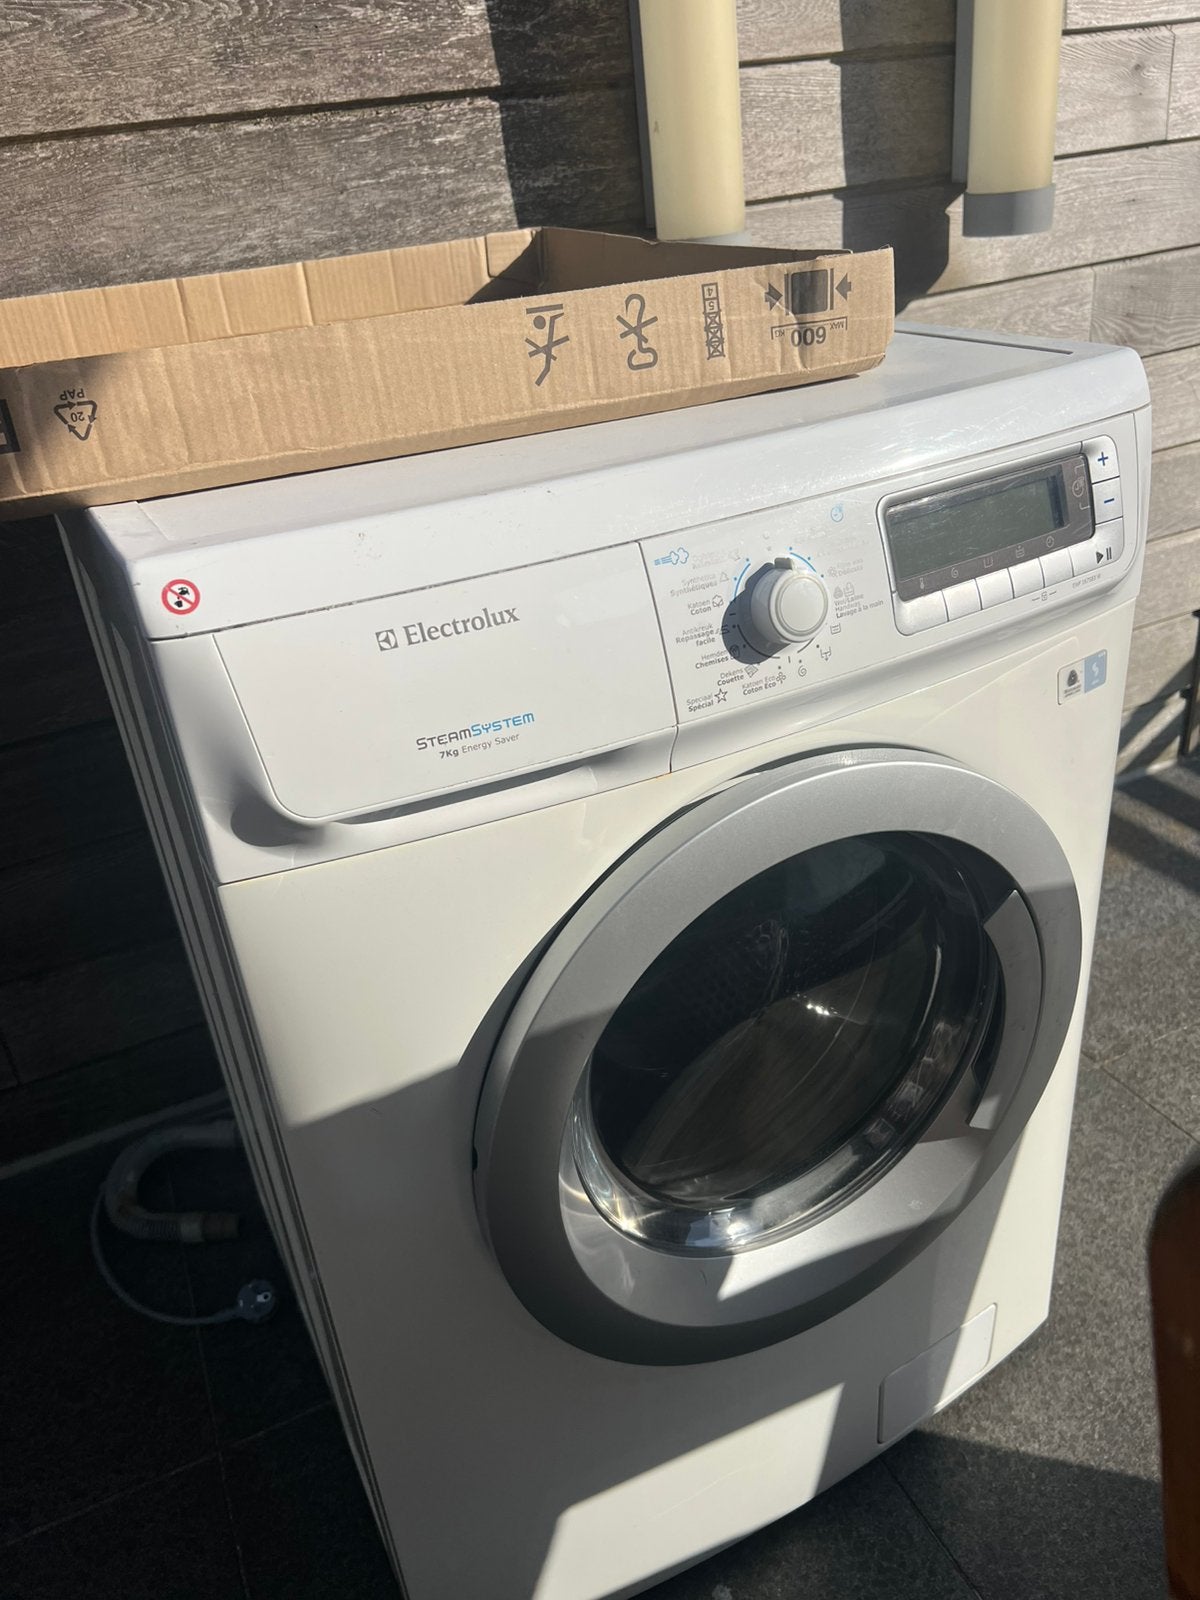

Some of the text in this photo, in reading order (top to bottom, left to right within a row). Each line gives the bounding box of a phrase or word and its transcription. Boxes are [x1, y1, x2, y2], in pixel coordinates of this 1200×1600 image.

[707, 287, 714, 297] 4
[708, 300, 715, 311] 5
[774, 320, 845, 347] MAX 600 KG
[59, 388, 85, 401] PAP
[70, 411, 85, 423] 20
[670, 580, 718, 598] Synthétiques
[687, 599, 711, 610] Katoen
[690, 606, 712, 616] Coton
[836, 607, 858, 619] Lavage
[869, 600, 884, 609] main
[403, 607, 521, 646] Electrolux
[682, 623, 713, 636] Antikreuk
[675, 629, 715, 644] Repassage
[695, 637, 716, 647] facile
[701, 649, 727, 661] Hemden
[695, 656, 729, 669] Chemises
[720, 668, 744, 679] Dekens
[717, 674, 745, 687] Couette
[742, 675, 776, 689] Katoen Eco
[743, 681, 777, 696] Coton Eco
[686, 692, 714, 706] Speciaal
[688, 699, 714, 712] Spécial
[439, 733, 520, 759] 7Kg Energy Saver
